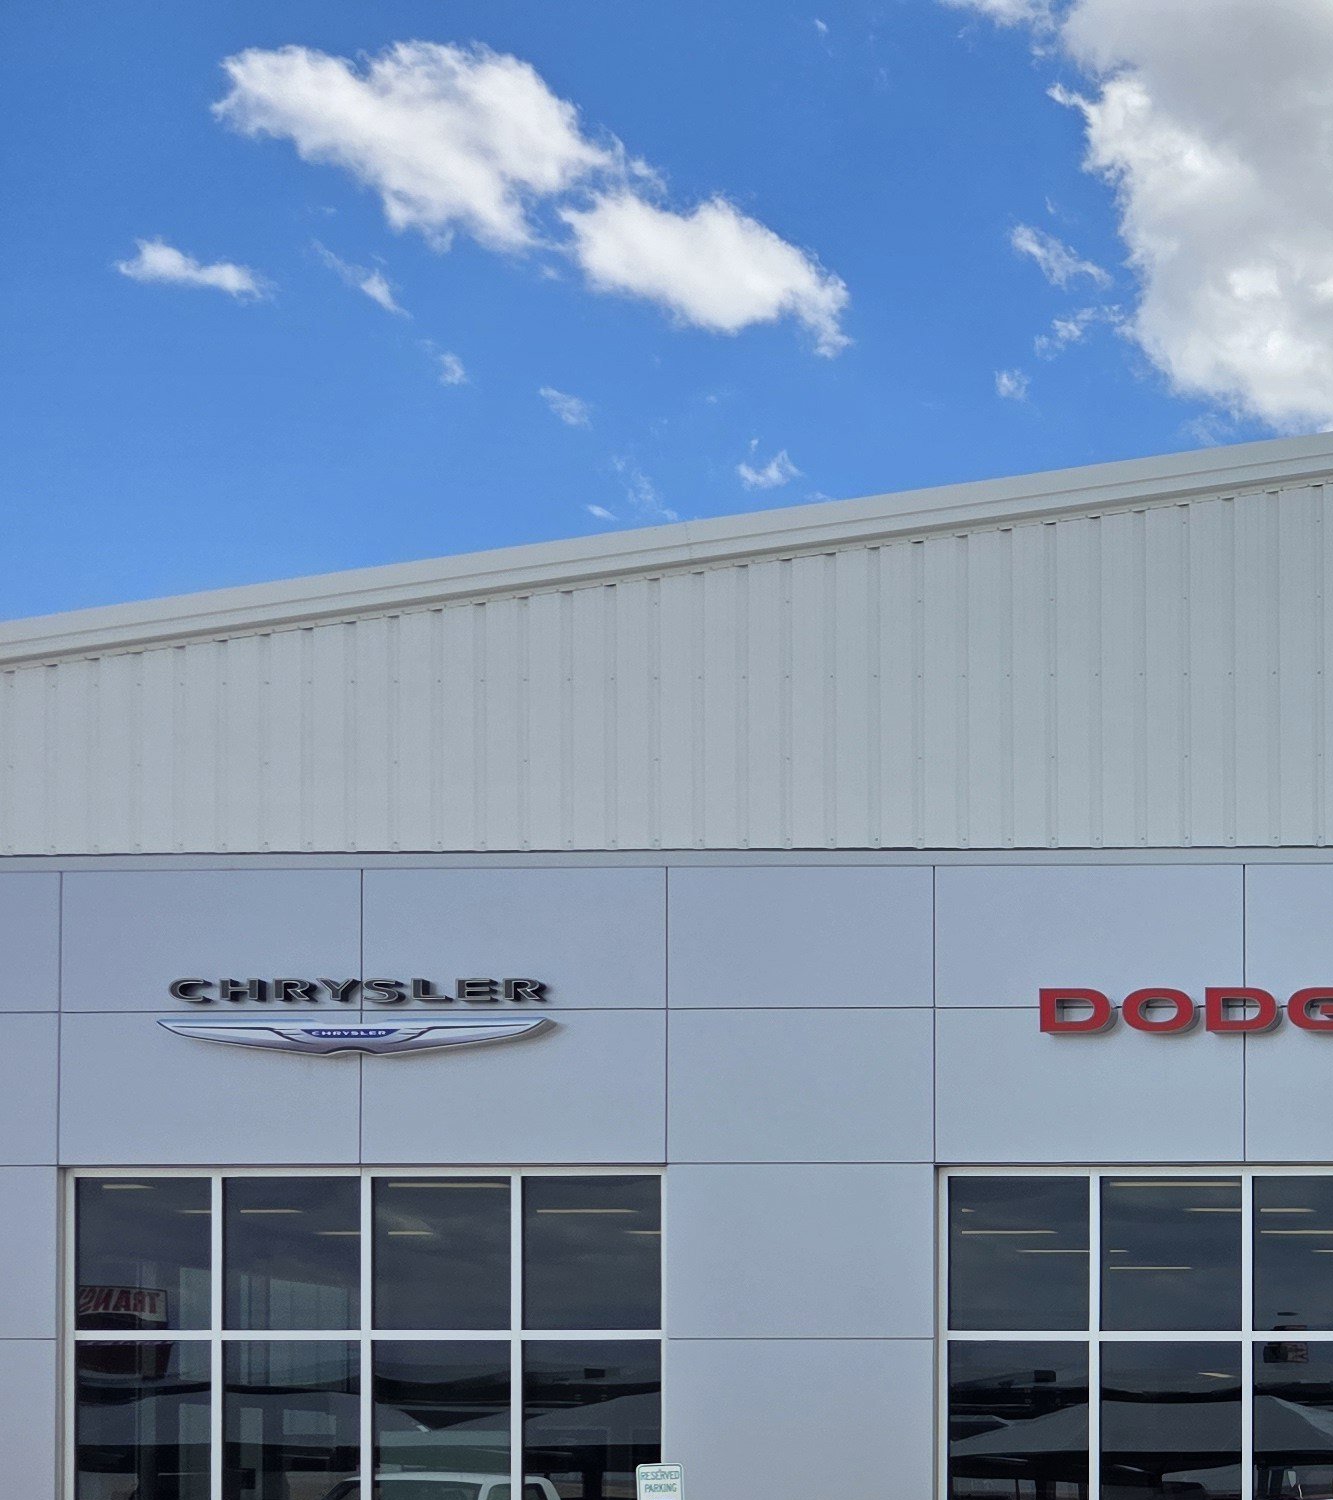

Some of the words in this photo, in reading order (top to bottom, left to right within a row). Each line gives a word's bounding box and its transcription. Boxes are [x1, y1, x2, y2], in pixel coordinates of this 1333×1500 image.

[168, 977, 549, 1006] CHRYSLER
[640, 1471, 680, 1481] RESERVED
[644, 1483, 677, 1493] PARKING
